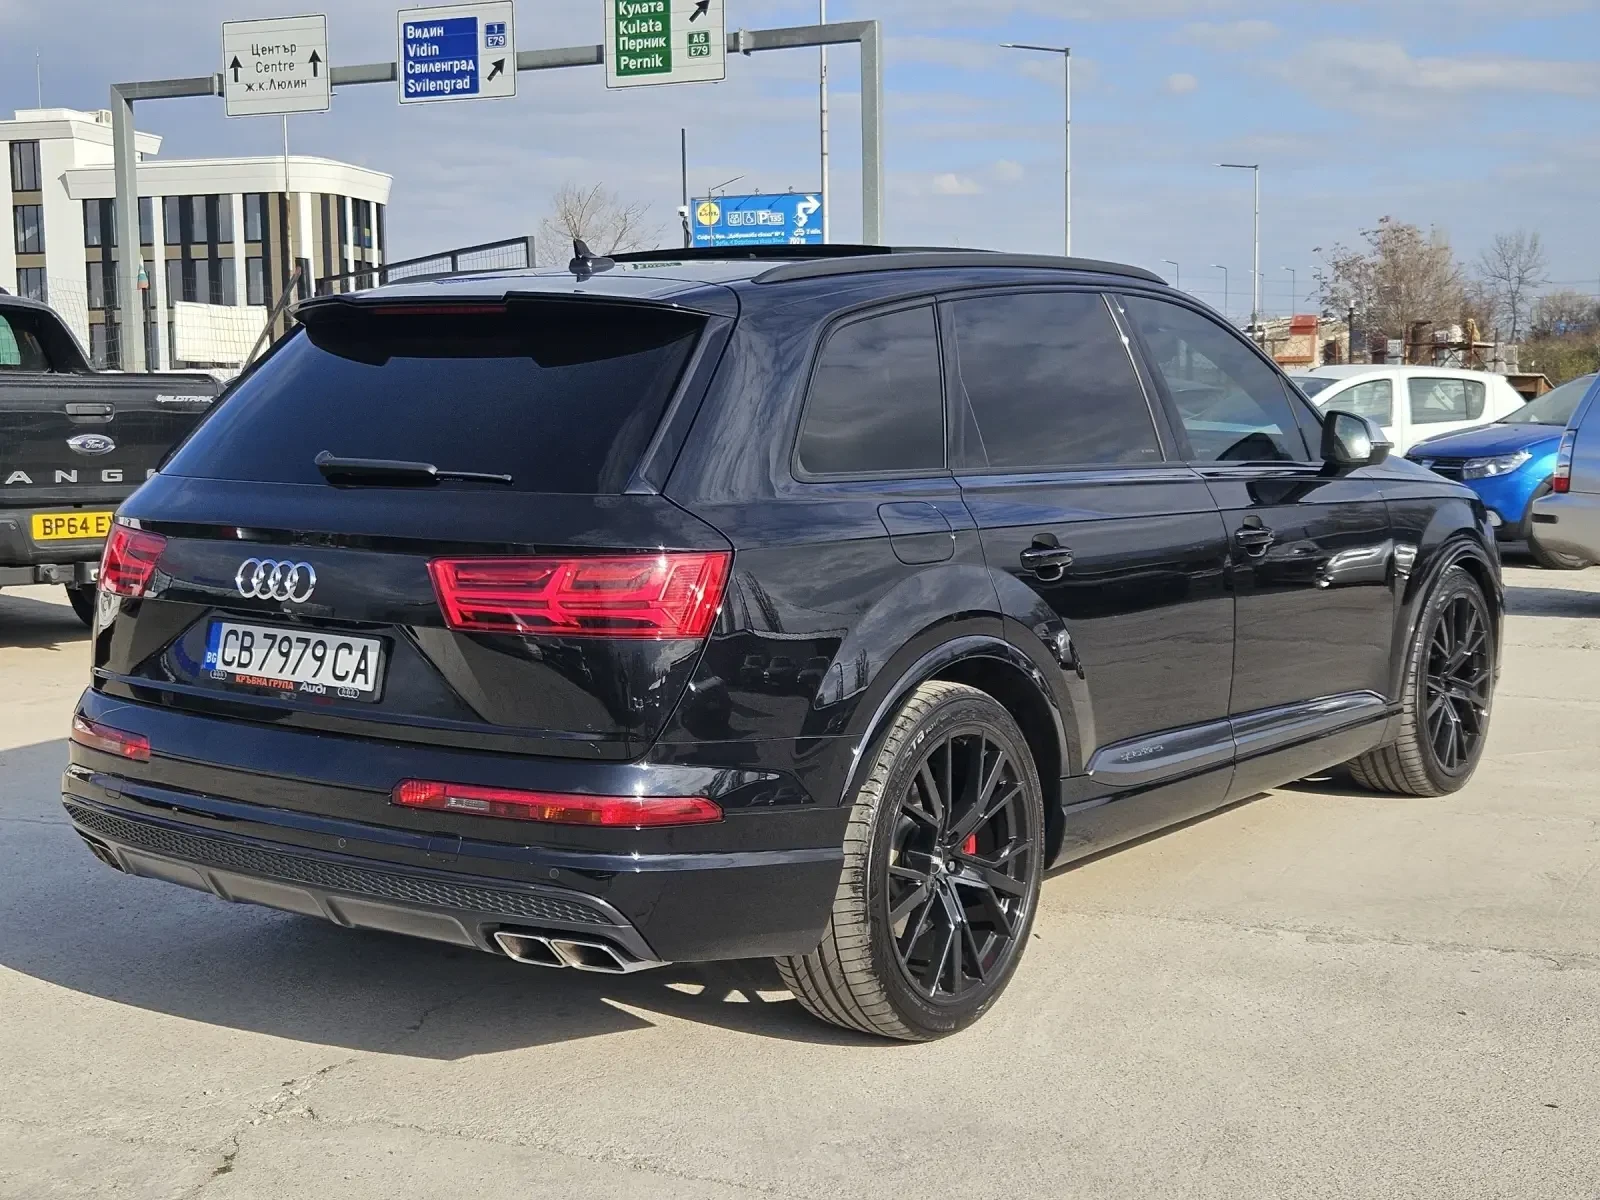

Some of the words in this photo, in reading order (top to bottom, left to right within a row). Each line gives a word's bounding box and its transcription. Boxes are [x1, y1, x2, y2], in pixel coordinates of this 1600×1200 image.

[619, 1, 664, 18] Кулата
[407, 25, 444, 39] Видин
[619, 19, 662, 34] Kulata
[488, 36, 505, 46] E79
[619, 36, 666, 52] Перник
[692, 34, 705, 43] A6
[251, 43, 297, 57] Център
[407, 43, 439, 57] Vidin
[690, 46, 708, 56] E79
[255, 61, 295, 73] Centre
[407, 59, 476, 74] Свиленград
[620, 54, 663, 70] Pernik
[245, 78, 307, 92] ж.к.Люлин
[407, 75, 470, 94] Svilengrad
[85, 439, 104, 449] Ford
[42, 516, 89, 536] BP64
[206, 651, 217, 663] BG
[235, 674, 268, 687] КРЪВНА
[268, 679, 294, 690] ГРУПА
[300, 681, 327, 695] Audi
